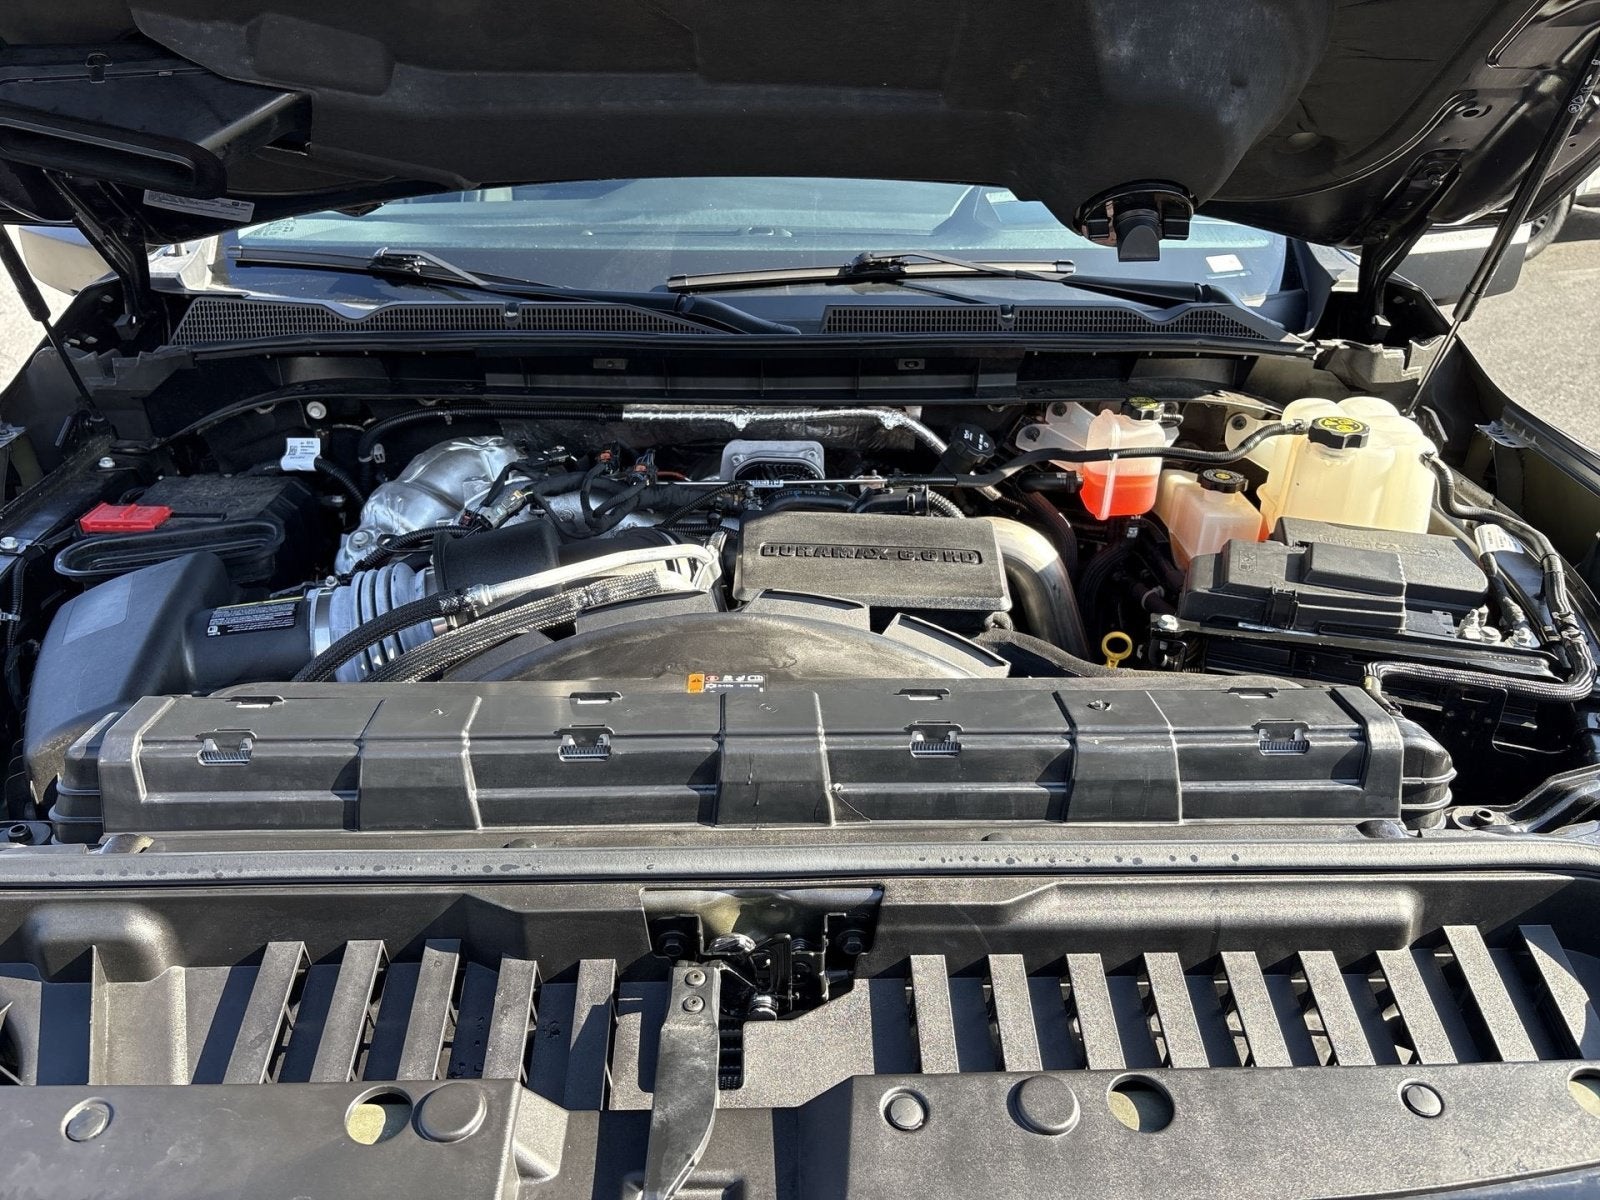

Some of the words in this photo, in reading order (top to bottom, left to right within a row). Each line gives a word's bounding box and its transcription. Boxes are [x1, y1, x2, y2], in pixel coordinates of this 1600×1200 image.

[763, 544, 888, 560] DURAMAX
[897, 549, 939, 562] 6.6
[943, 550, 979, 564] HD
